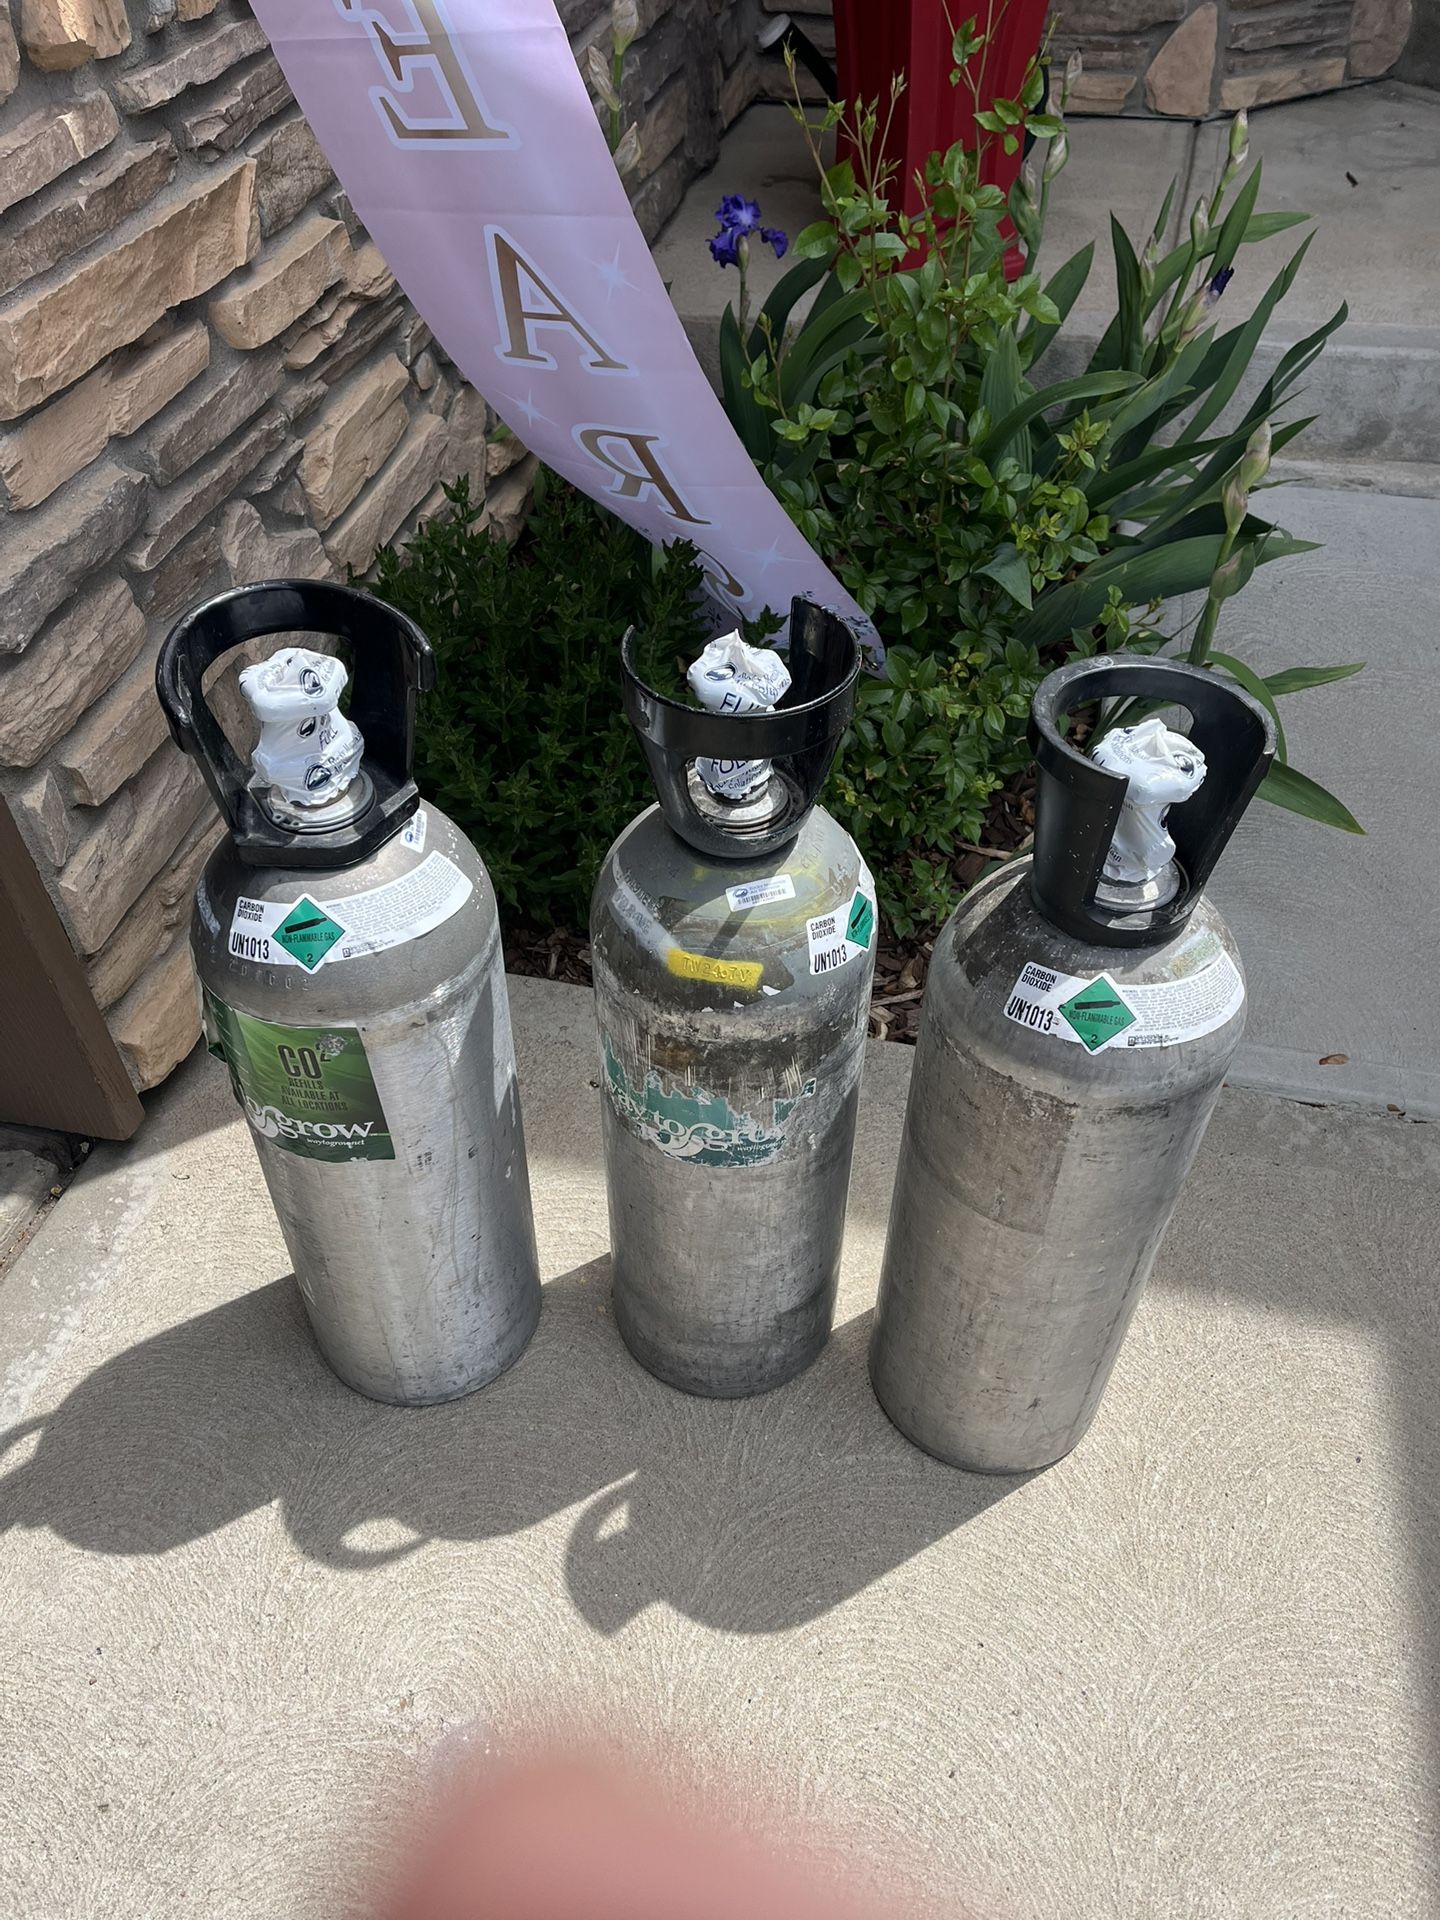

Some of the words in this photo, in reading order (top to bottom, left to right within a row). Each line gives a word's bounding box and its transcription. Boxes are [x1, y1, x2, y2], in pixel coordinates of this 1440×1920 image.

[238, 900, 264, 913] CARBON
[237, 908, 262, 922] DIOXIDE
[810, 916, 836, 932] CARBON
[812, 925, 837, 941] DIOXIDE
[231, 932, 270, 959] UN1013
[306, 953, 314, 962] 2
[814, 944, 848, 973] UN1013
[1024, 965, 1057, 984] CARBON
[1020, 974, 1053, 992] DIOXIDE
[1007, 996, 1054, 1031] UN1013
[1090, 1034, 1098, 1044] 2
[288, 1077, 324, 1090] REFILLS
[281, 1086, 327, 1101] AVAILABLE
[328, 1091, 341, 1101] AT
[297, 1099, 349, 1112] LOCATIONS
[276, 1113, 375, 1139] grow
